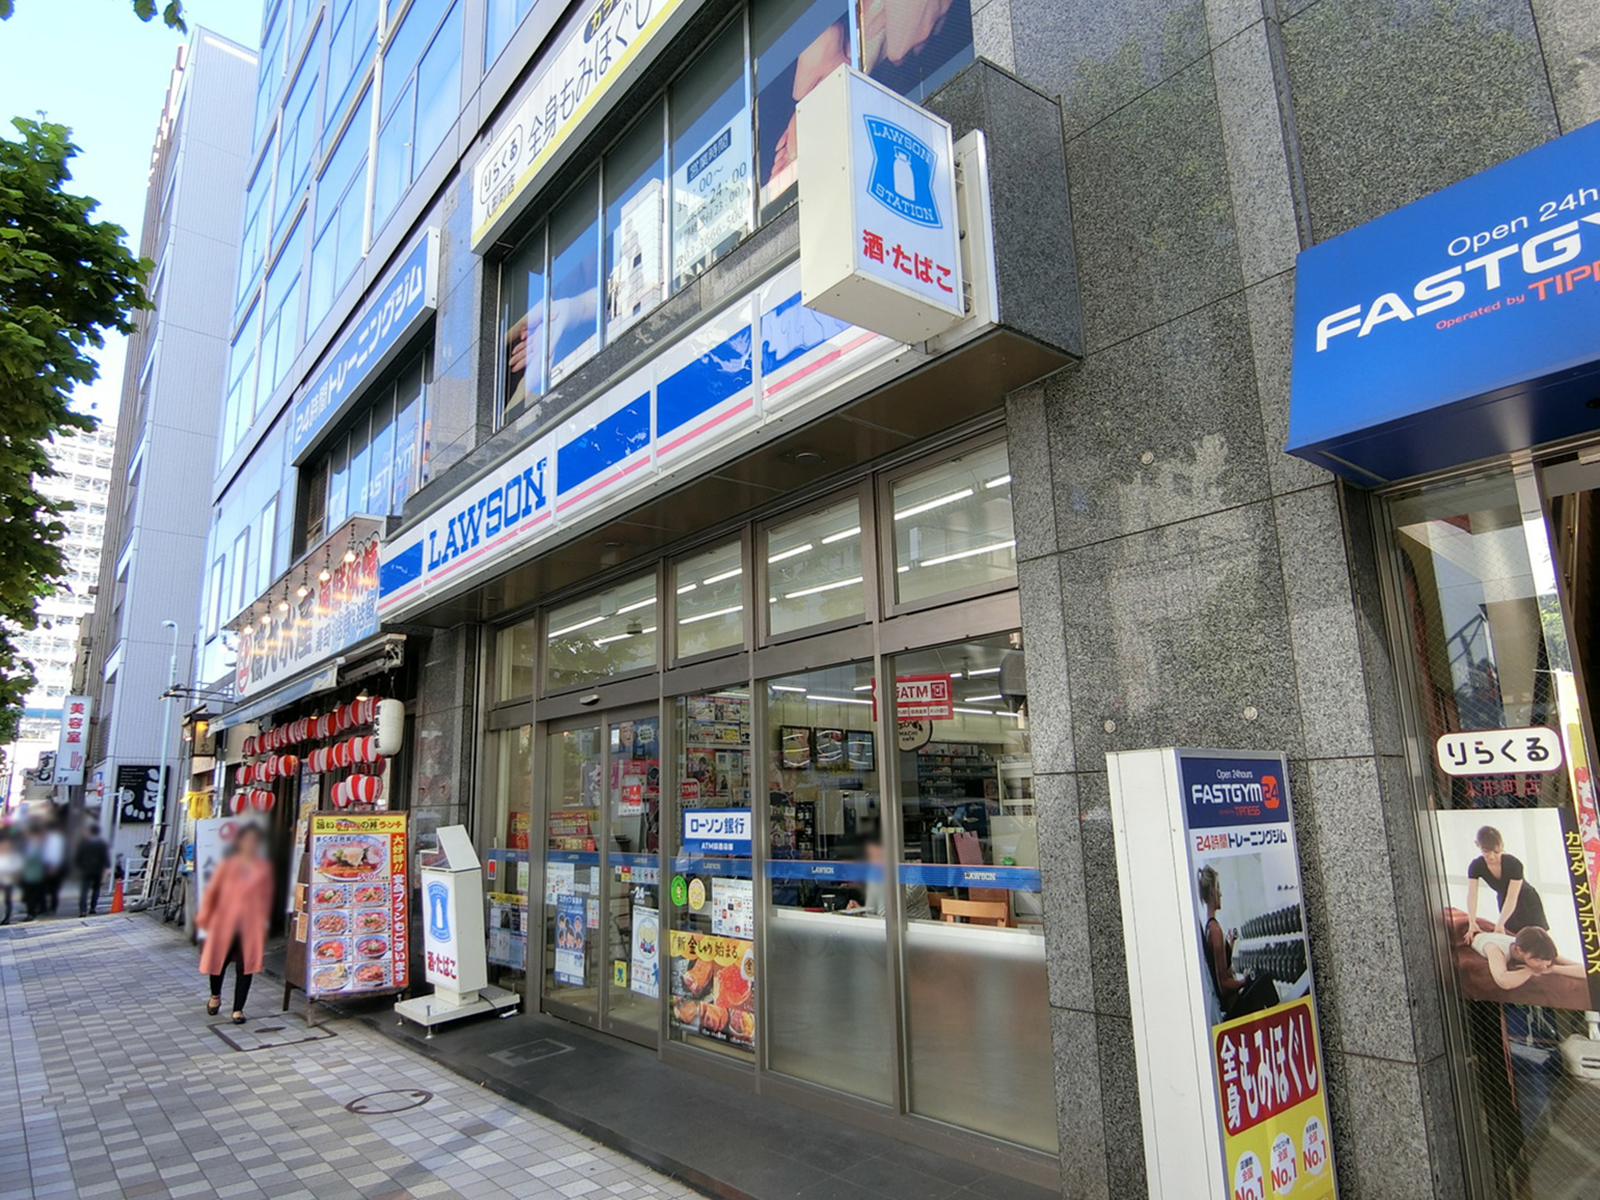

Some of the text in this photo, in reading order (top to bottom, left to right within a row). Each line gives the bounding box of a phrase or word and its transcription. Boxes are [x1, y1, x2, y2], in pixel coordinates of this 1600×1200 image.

[872, 122, 932, 165] LAWSON
[484, 138, 518, 192] りらくる
[875, 183, 934, 221] STATION
[1448, 216, 1528, 257] Open
[863, 229, 953, 293] 酒・たばこ
[1316, 212, 1600, 352] FASTG
[1436, 302, 1501, 330] Operated
[1506, 294, 1525, 307] by
[295, 264, 423, 444] 24時間トレーニングジム
[428, 457, 547, 572] LAWSON
[66, 702, 85, 743] 美容室
[1447, 737, 1549, 766] りらくる
[1216, 769, 1231, 780] Open
[1464, 778, 1541, 797] 人形町店
[690, 817, 745, 834] ローソン銀行
[1196, 829, 1288, 851] 24時間トレーニングジム
[1565, 831, 1600, 974] カラダ メンテナンス
[1271, 1157, 1297, 1191] No.1
[1303, 1139, 1327, 1171] No.1
